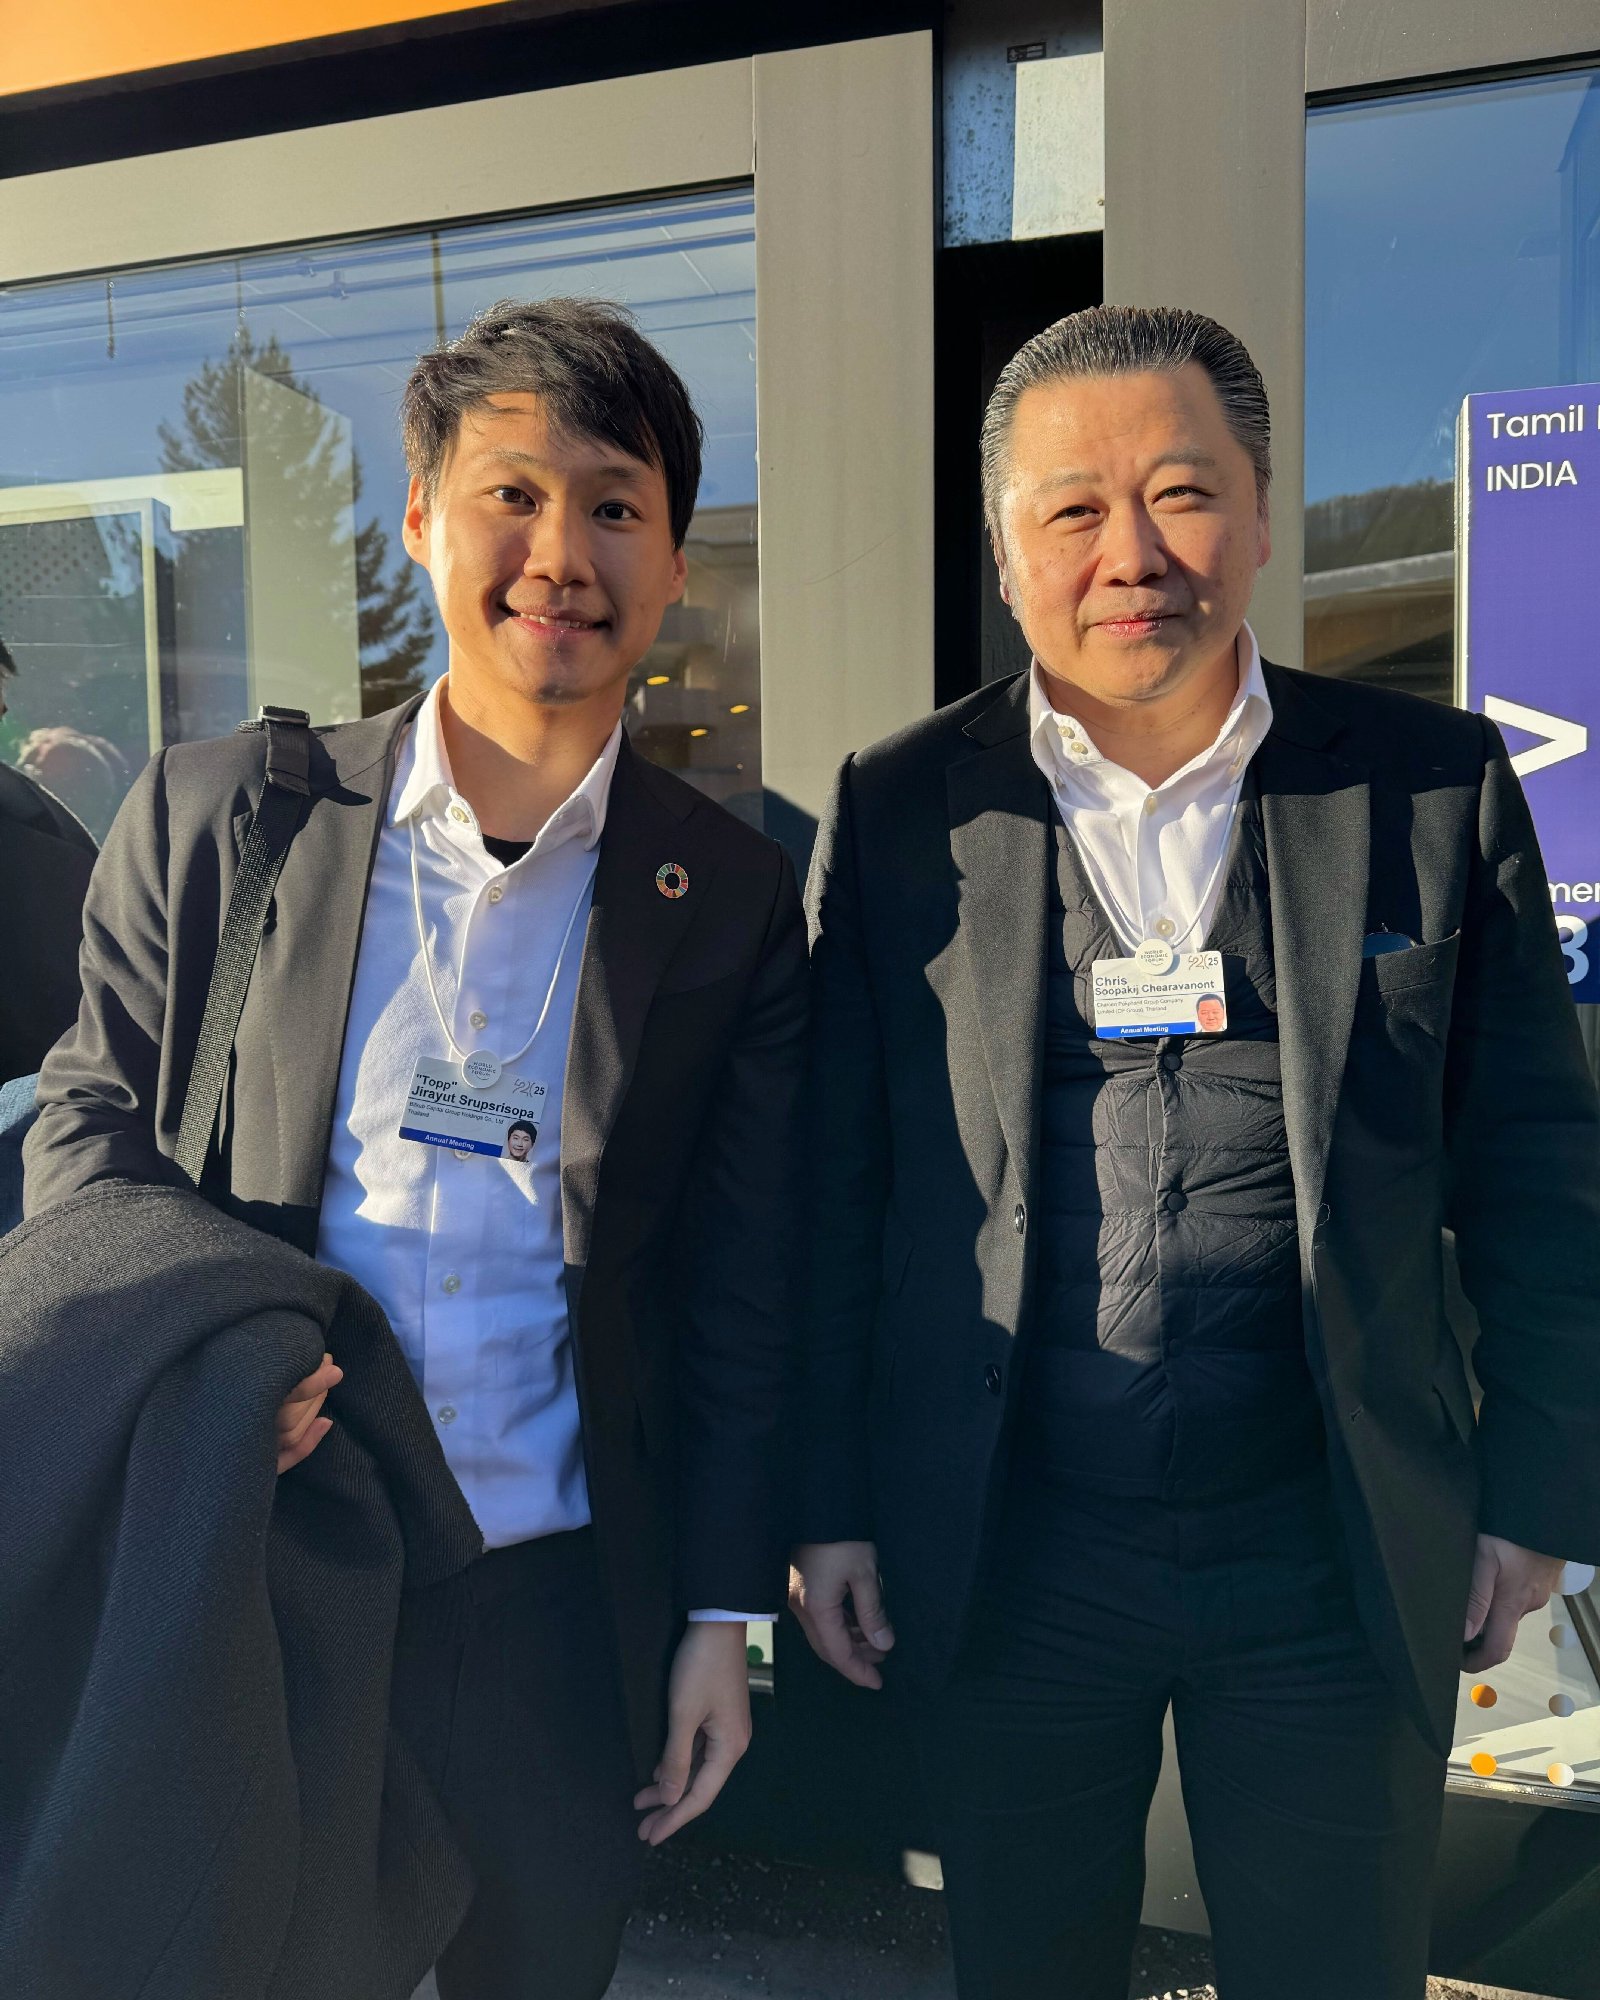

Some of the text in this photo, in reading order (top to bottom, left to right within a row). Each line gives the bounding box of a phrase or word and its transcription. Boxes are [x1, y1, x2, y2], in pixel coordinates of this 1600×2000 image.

[1486, 404, 1584, 439] Tamil
[1487, 460, 1578, 492] INDIA
[1208, 957, 1219, 966] 25
[1095, 976, 1128, 987] Chris
[1095, 980, 1215, 996] Soopakij Chearavanont
[416, 1073, 458, 1091] "Topp"
[533, 1086, 545, 1096] 25
[411, 1085, 535, 1119] Jirayut Srupsrisopa
[424, 1134, 476, 1150] Annual Meeting
